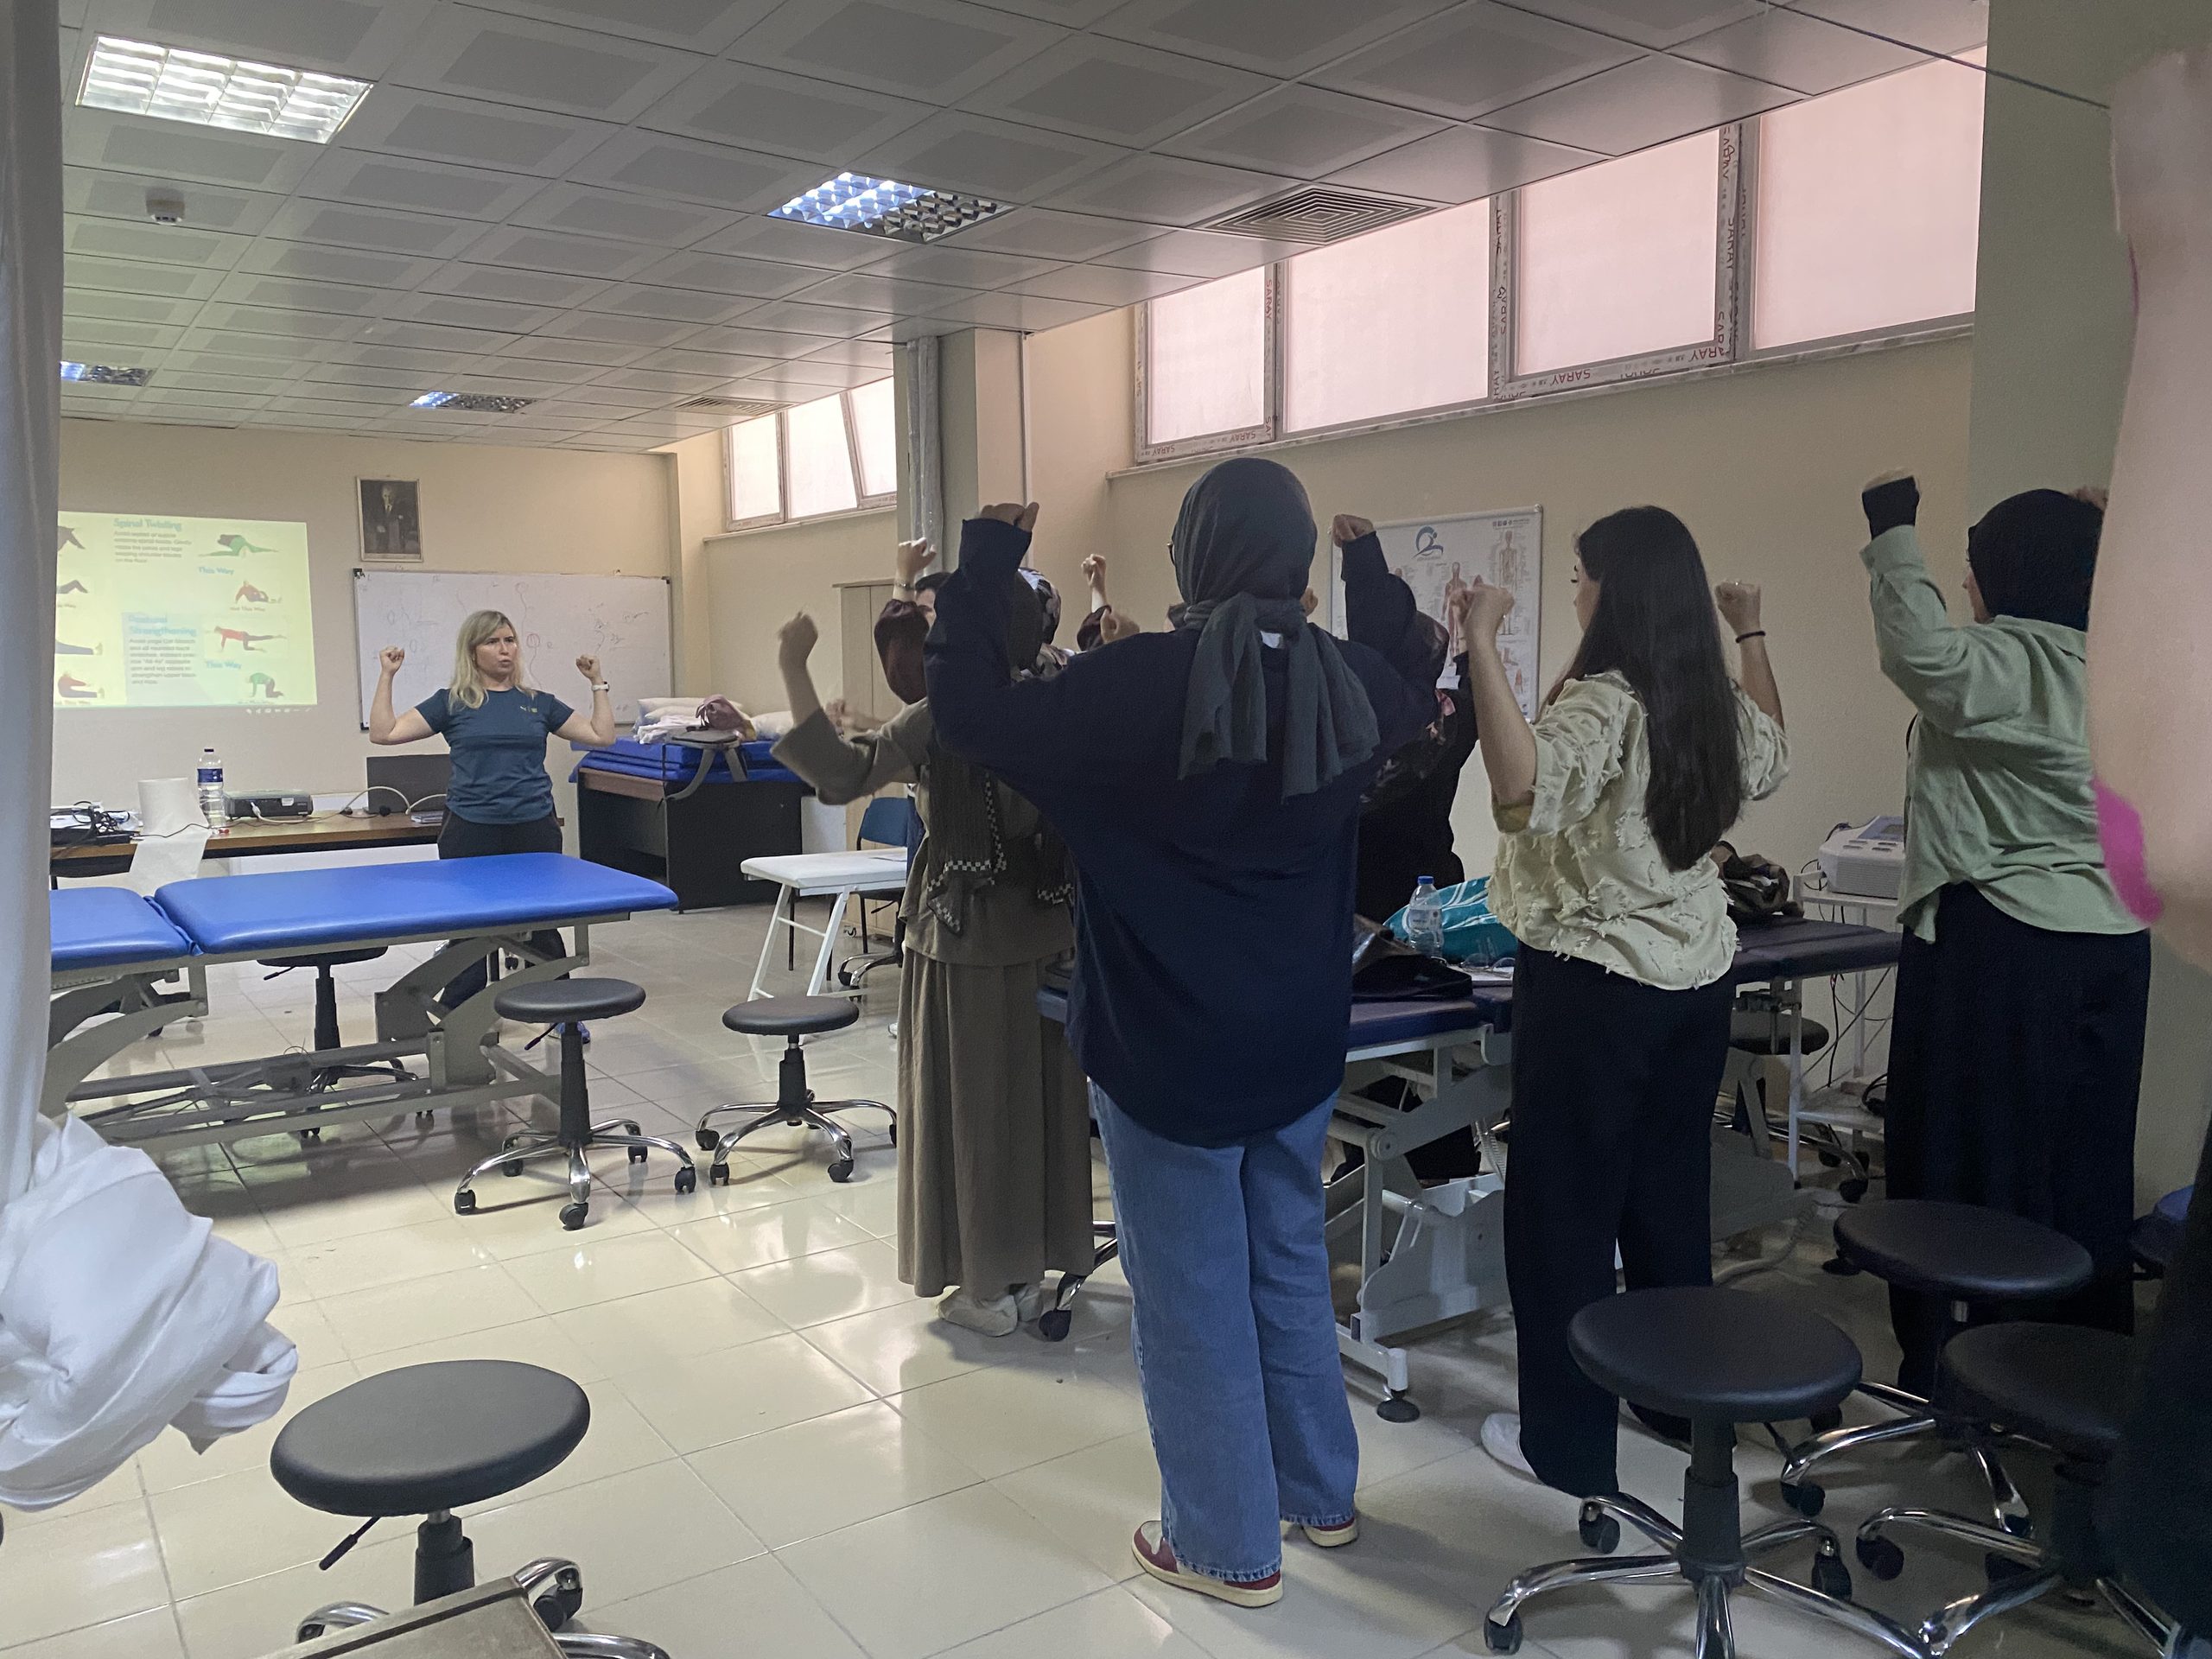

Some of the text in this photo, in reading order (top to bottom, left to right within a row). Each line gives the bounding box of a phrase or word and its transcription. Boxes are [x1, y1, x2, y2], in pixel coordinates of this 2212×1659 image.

[1549, 369, 1591, 387] SARAY
[1230, 430, 1256, 443] SARAY
[1152, 444, 1175, 457] SARAY
[199, 566, 235, 576] This Way
[207, 660, 242, 670] This Way
